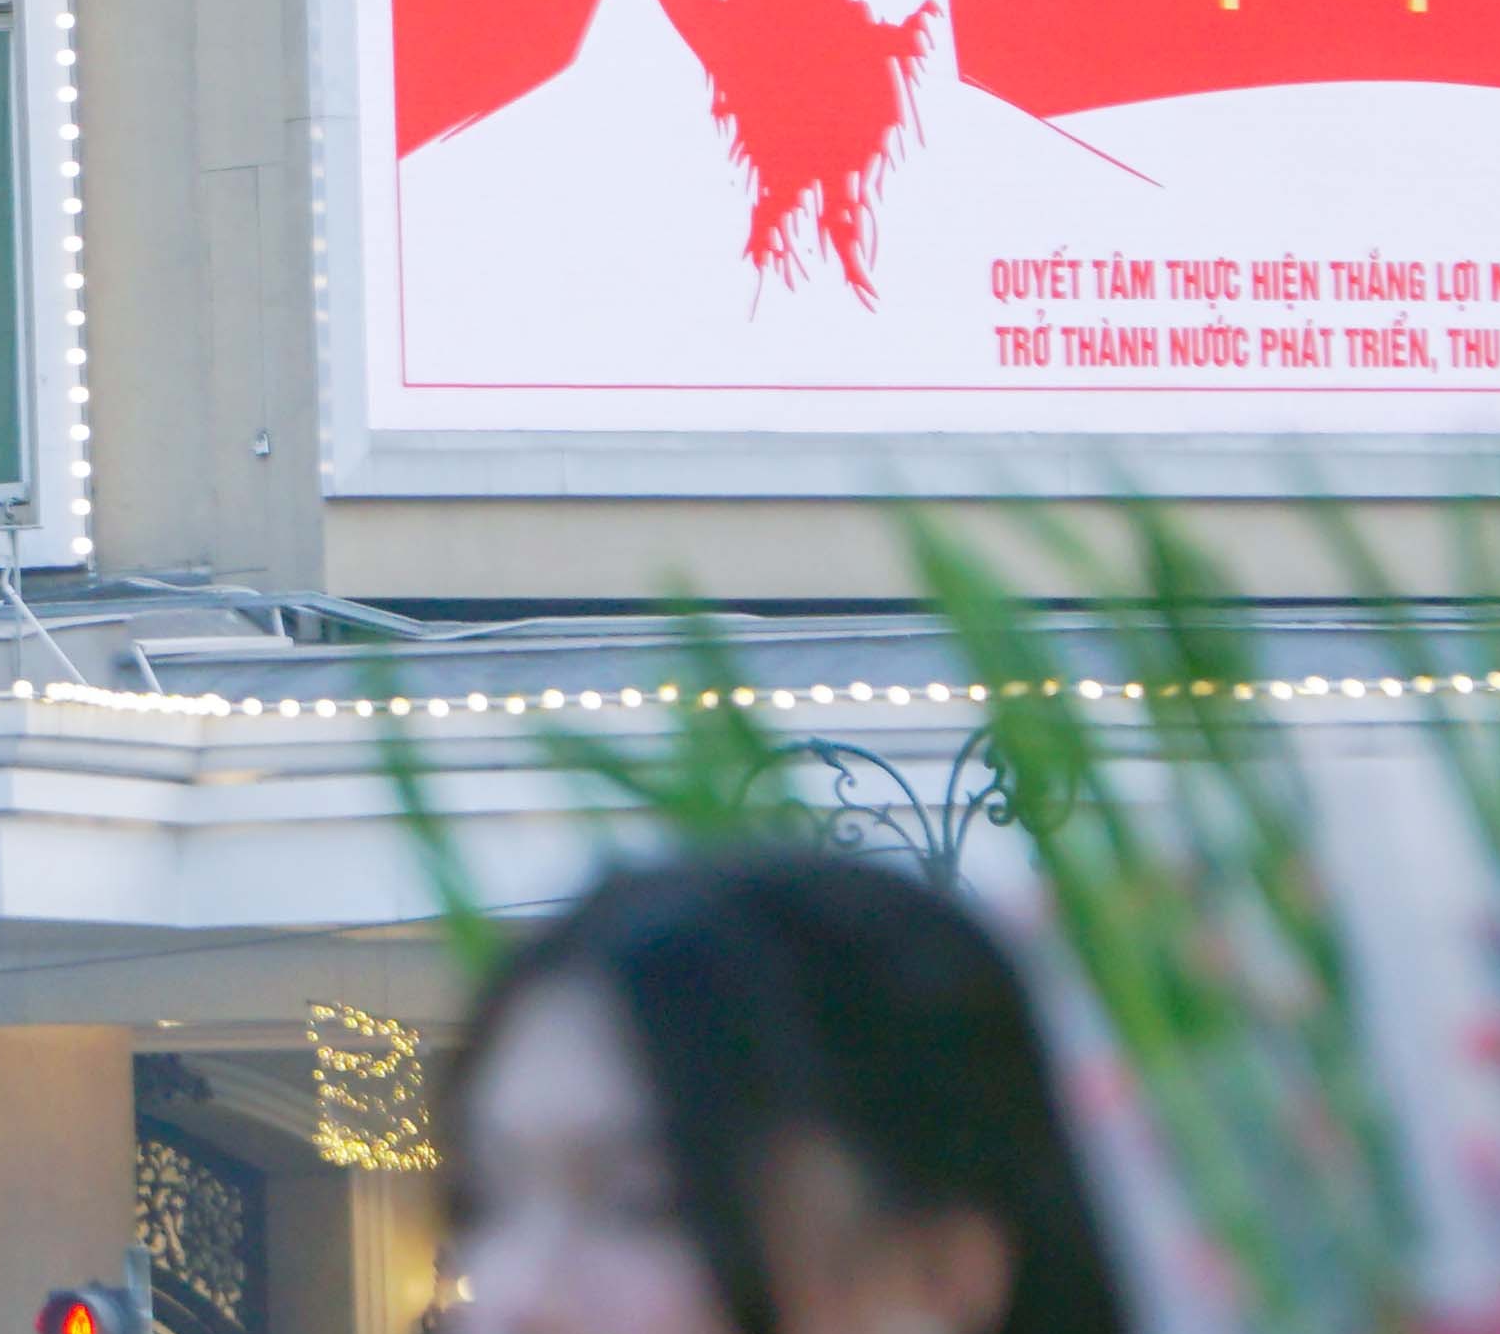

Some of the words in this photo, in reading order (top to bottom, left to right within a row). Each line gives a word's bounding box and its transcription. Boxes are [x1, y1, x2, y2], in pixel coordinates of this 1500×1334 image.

[991, 244, 1082, 304] QUYẾT
[1092, 251, 1156, 300] TÂM
[1165, 257, 1241, 310] THỰC
[1252, 253, 1320, 311] HIỆN
[1330, 246, 1426, 301] THẮNG
[1437, 259, 1480, 311] LỢI
[995, 308, 1053, 367] TRỞ
[1060, 317, 1158, 368] THÀNH
[1169, 315, 1250, 368] NƯỚC
[1260, 319, 1333, 368] PHÁT
[1344, 310, 1439, 375] TRIỂN,
[1447, 327, 1500, 369] THU
